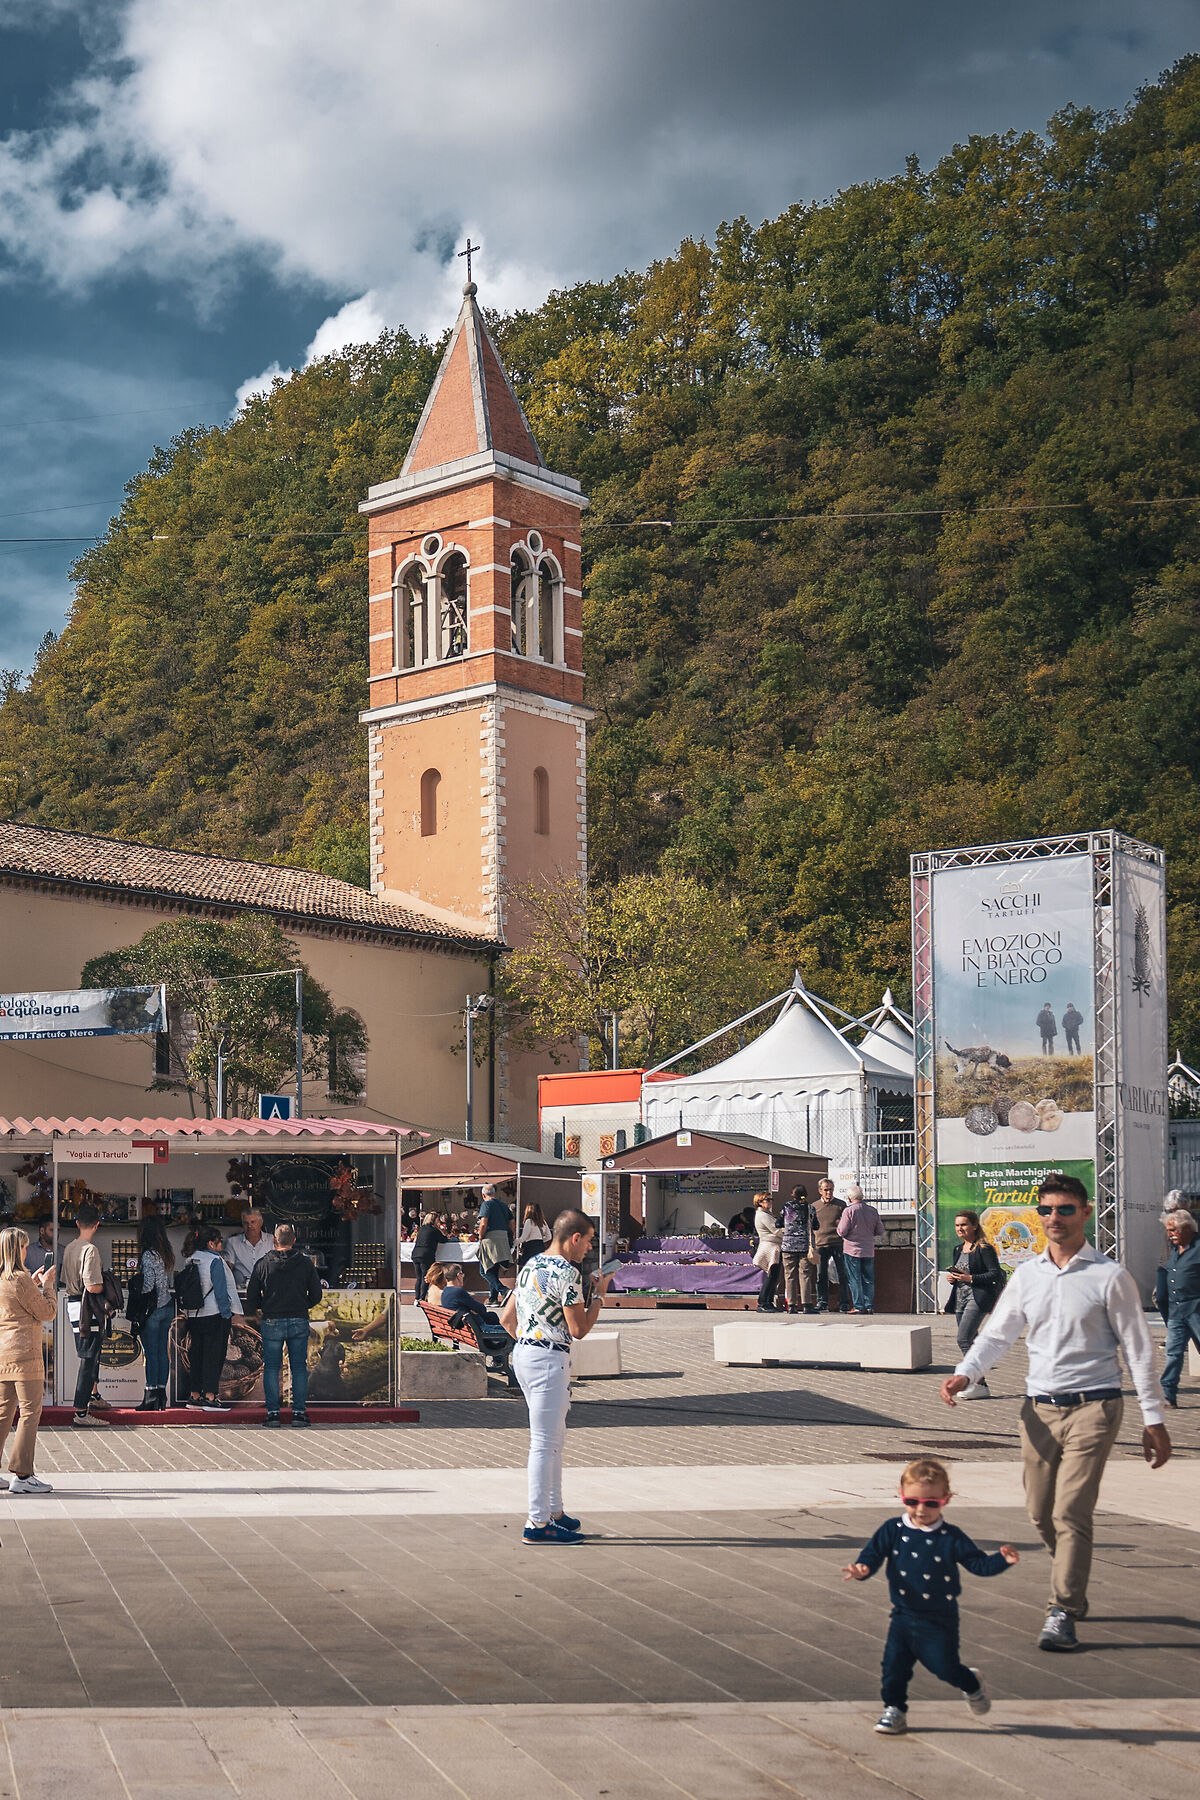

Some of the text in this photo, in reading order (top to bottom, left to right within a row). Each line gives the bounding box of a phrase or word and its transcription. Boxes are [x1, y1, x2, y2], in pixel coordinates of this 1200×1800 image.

[981, 893, 1041, 911] SACCHI
[988, 908, 1035, 919] TARTUFI
[962, 931, 1061, 955] EMOZIONI
[962, 948, 1062, 972] IN BIANCO
[977, 966, 1047, 987] E NERO
[0, 1003, 80, 1018] acqualagna
[30, 1030, 66, 1039] Tartufo
[69, 1030, 94, 1038] Nero
[967, 1167, 1063, 1178] La Pasta Marchigiana
[984, 1178, 999, 1188] più
[1000, 1178, 1029, 1187] amata
